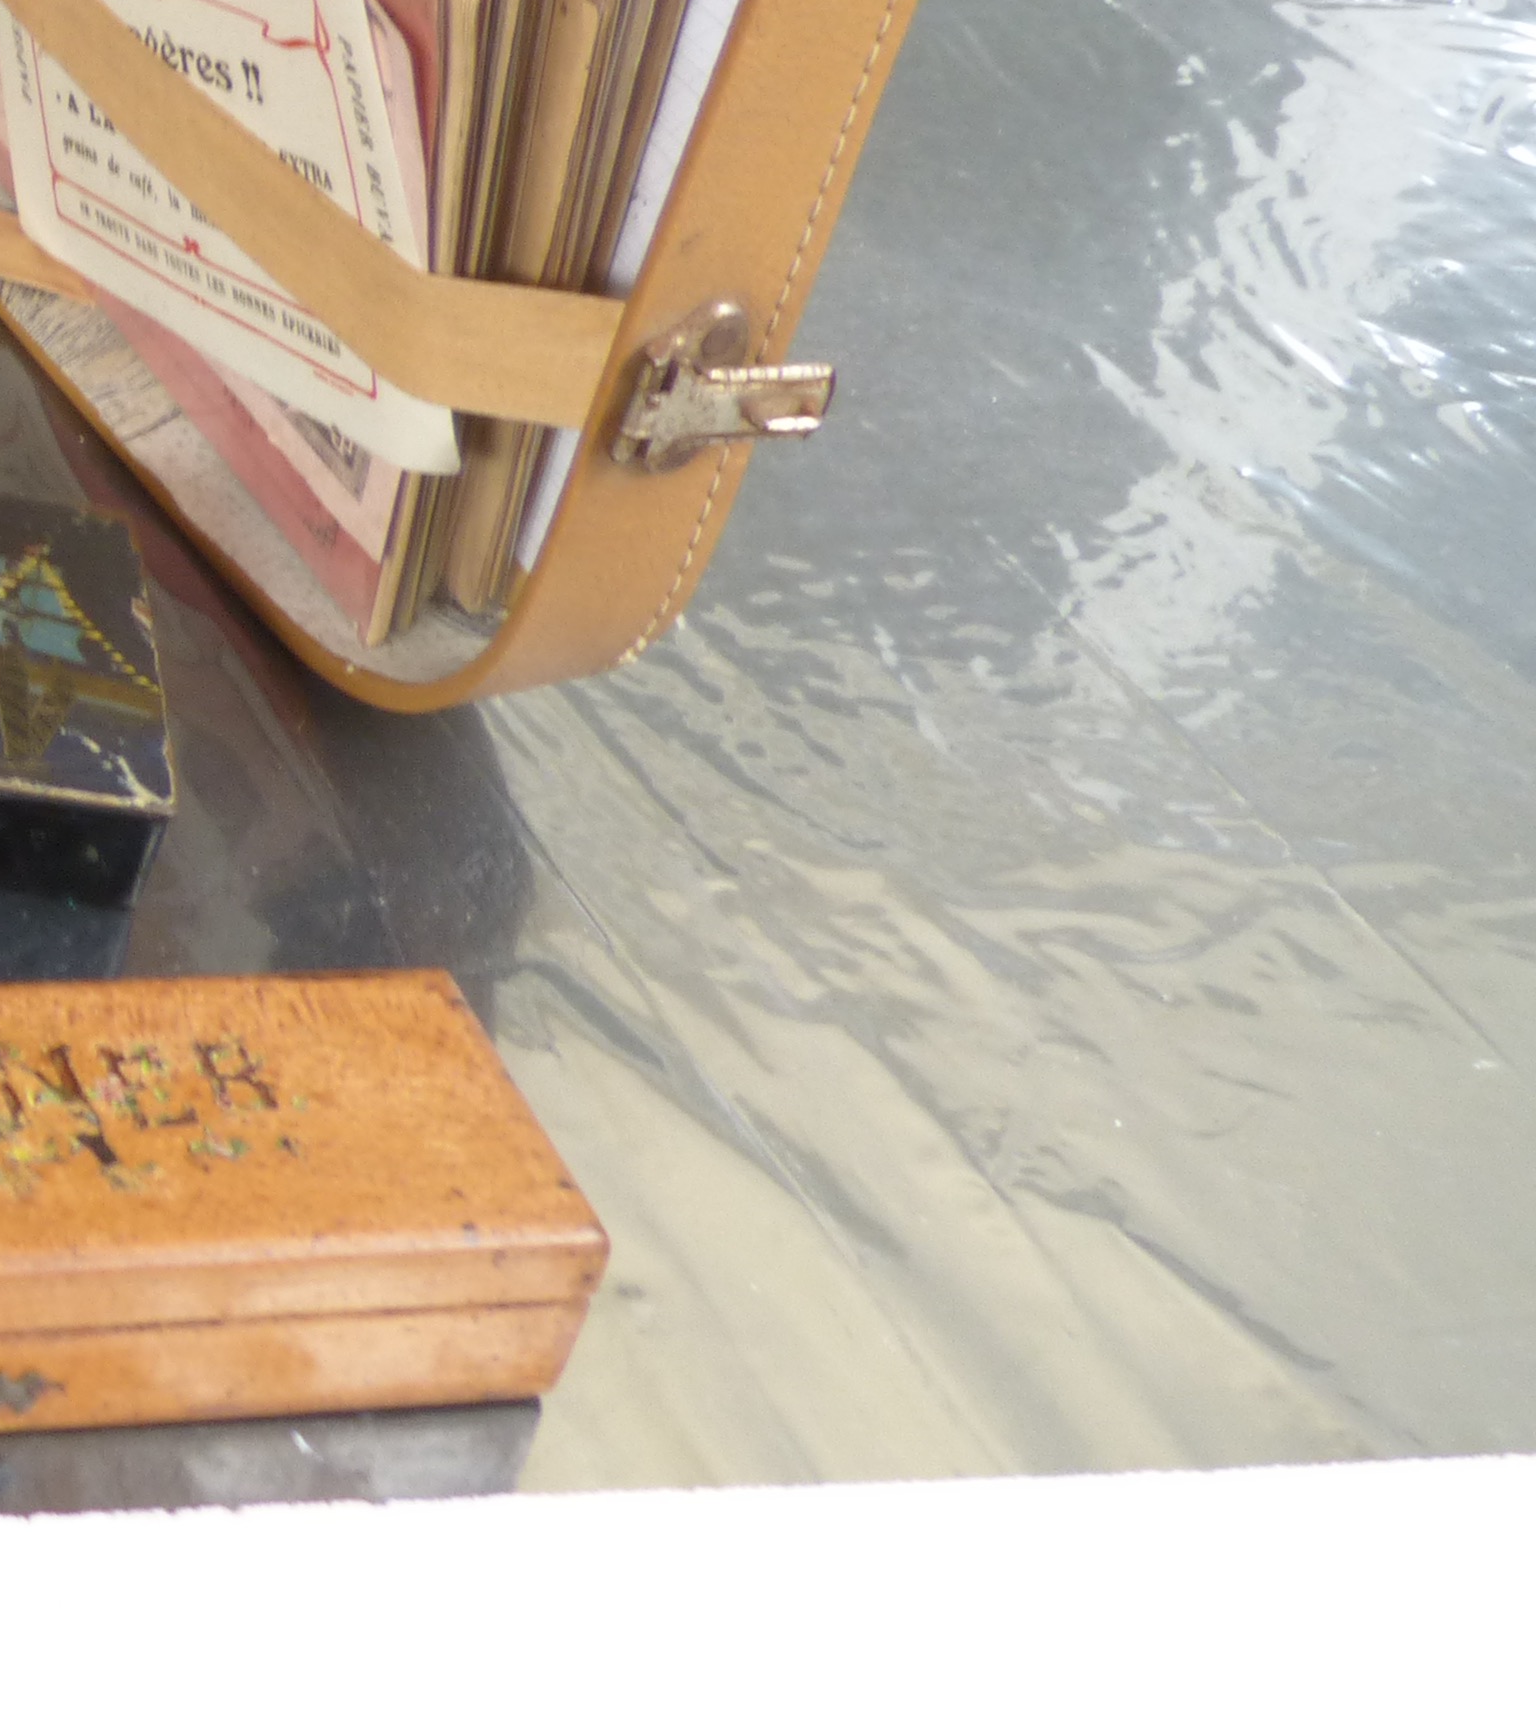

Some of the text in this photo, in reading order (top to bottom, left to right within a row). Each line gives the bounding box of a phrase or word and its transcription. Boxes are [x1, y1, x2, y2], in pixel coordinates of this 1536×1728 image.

[62, 134, 99, 166] grains
[106, 152, 121, 179] de
[128, 170, 159, 205] café,
[163, 248, 201, 284] TOUTES
[205, 271, 227, 298] LES
[231, 284, 277, 323] BONNES
